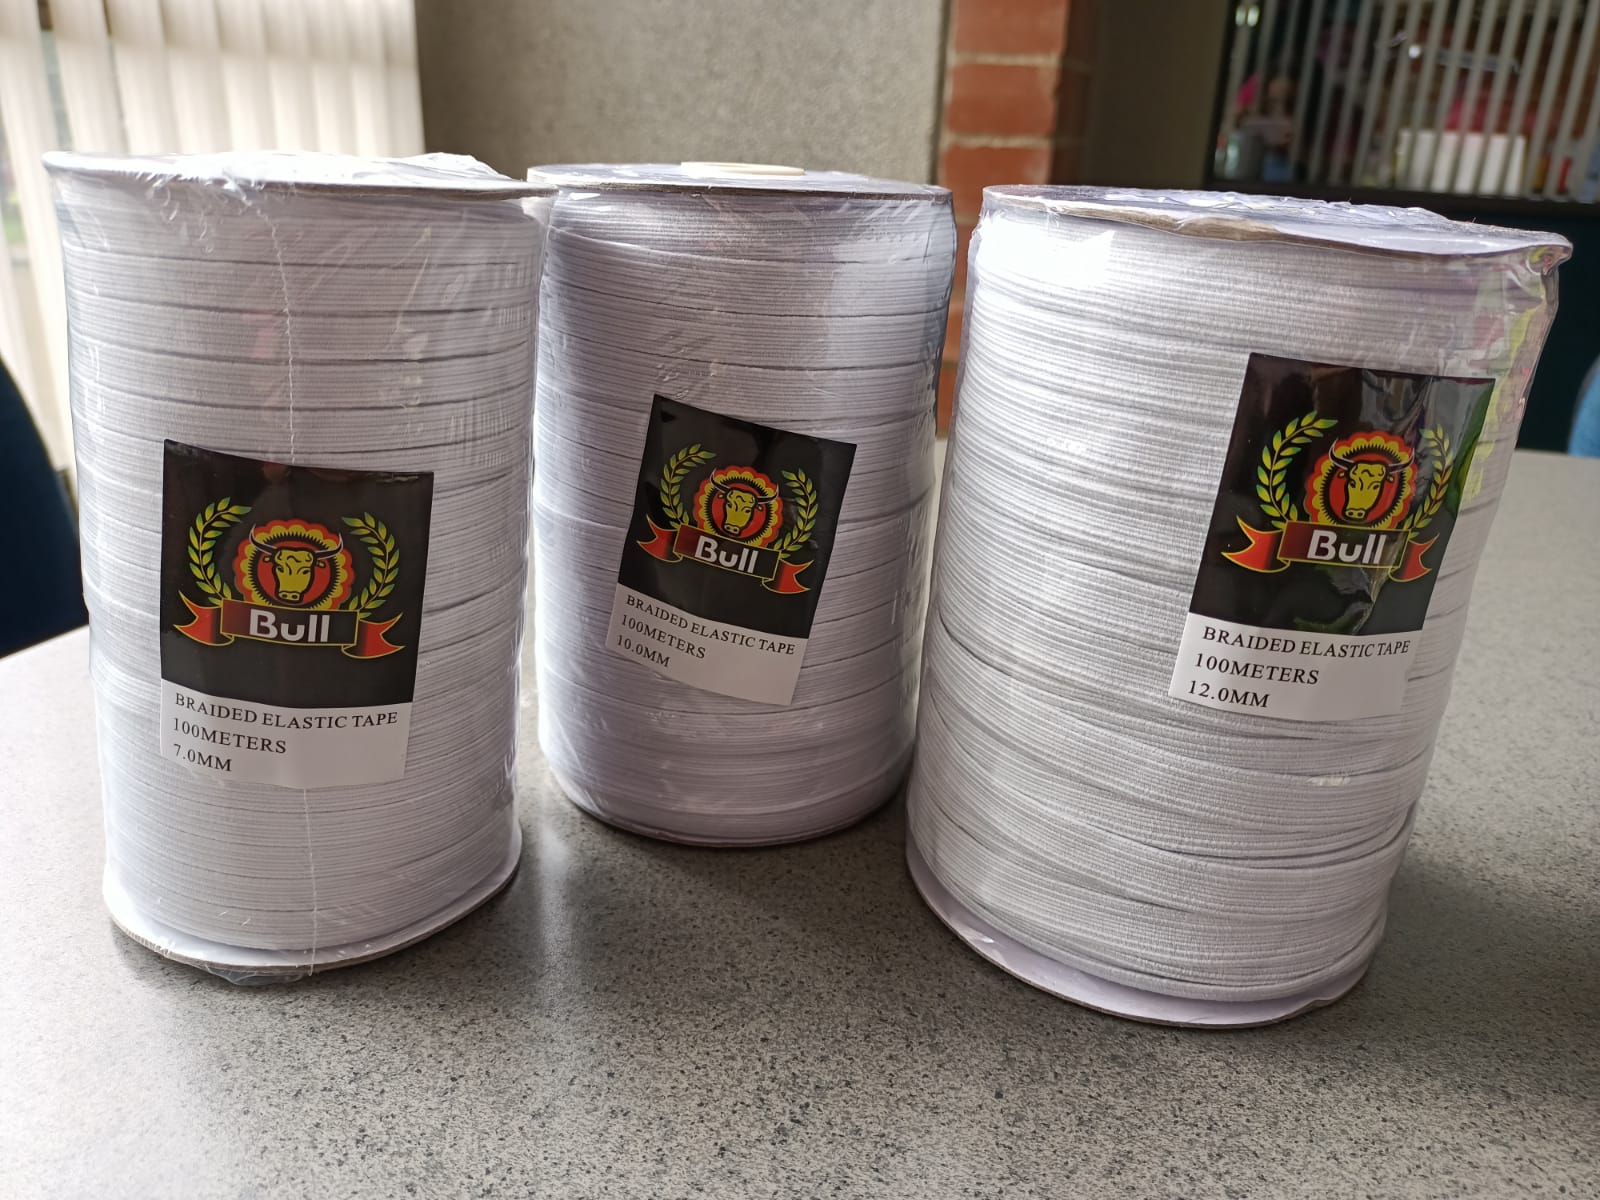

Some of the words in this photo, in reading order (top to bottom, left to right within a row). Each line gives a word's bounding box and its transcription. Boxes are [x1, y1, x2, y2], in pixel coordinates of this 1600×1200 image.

[694, 535, 759, 574] Bull
[1307, 529, 1387, 565] Bull
[249, 608, 331, 643] Bull
[620, 614, 707, 659] 100METERS
[626, 594, 688, 630] BRAIDED
[690, 622, 756, 648] ELASTIC
[758, 638, 796, 655] TAPE
[1202, 626, 1296, 654] BRAIDED
[1300, 640, 1375, 658] ELASTIC
[1376, 640, 1411, 657] TAPE
[616, 634, 671, 668] 10.0MM
[1194, 653, 1320, 685] 100METERS
[175, 692, 258, 724] BRAIDED
[262, 713, 347, 730] ELASTIC
[351, 711, 398, 728] TAPE
[1188, 680, 1270, 708] 12.0MM
[173, 717, 287, 754] 100METERS
[173, 744, 232, 772] 7.0MM
